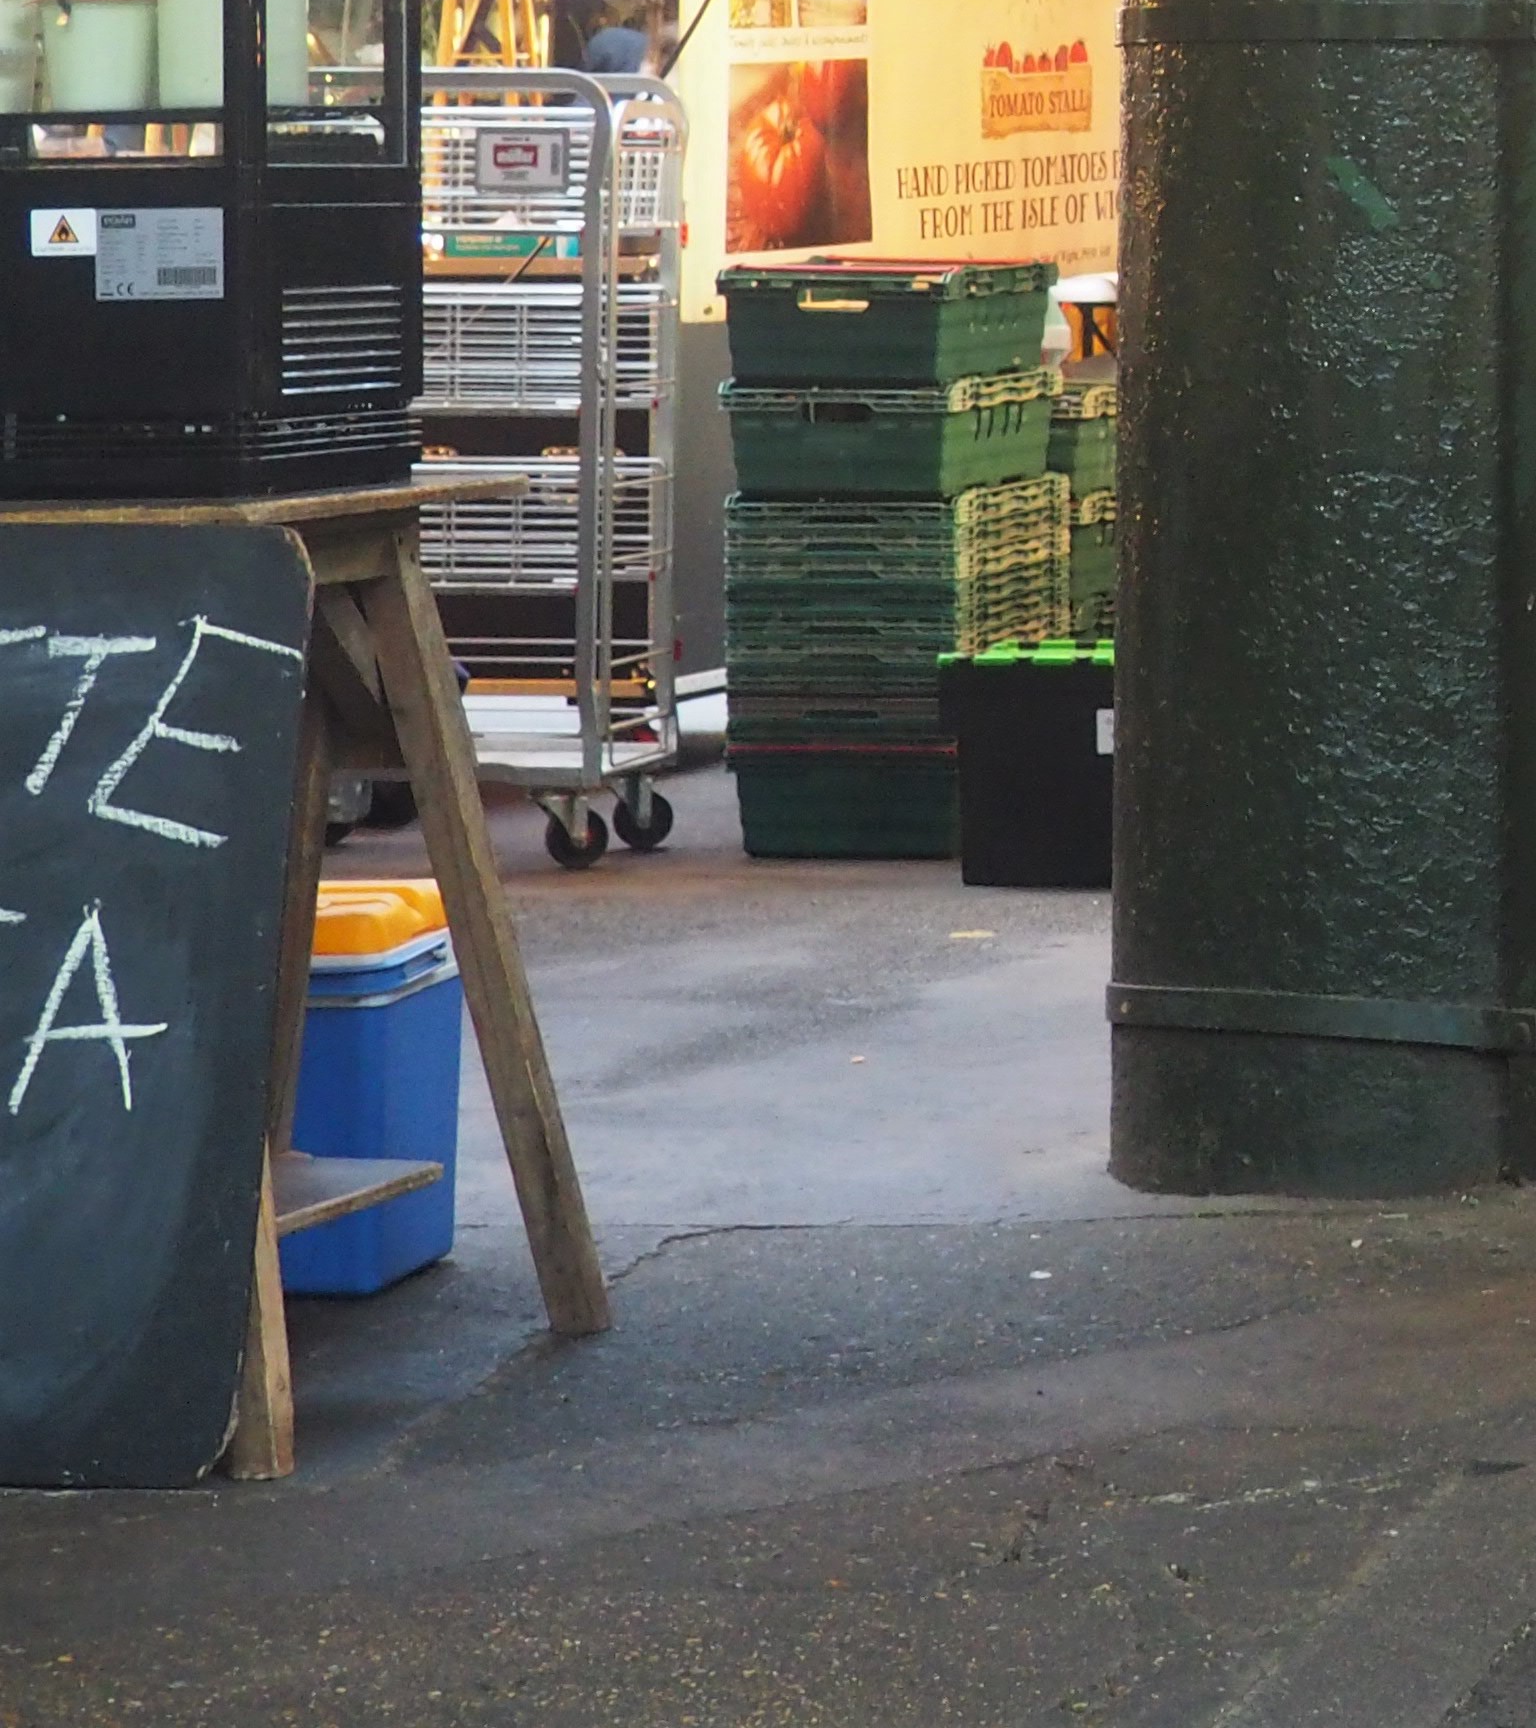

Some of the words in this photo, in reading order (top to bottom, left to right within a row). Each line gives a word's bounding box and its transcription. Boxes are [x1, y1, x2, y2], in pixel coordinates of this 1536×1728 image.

[989, 91, 1045, 119] TOMATO
[1049, 88, 1090, 114] STALL
[897, 164, 949, 200] HAND
[955, 159, 1015, 196] PICKED
[1021, 151, 1108, 189] TOMATOES
[919, 203, 974, 240] FROM
[981, 198, 1015, 235] THE
[1021, 194, 1059, 230] ISLE
[1065, 191, 1090, 225] OF
[0, 614, 304, 848] TE
[0, 898, 169, 1115] A
